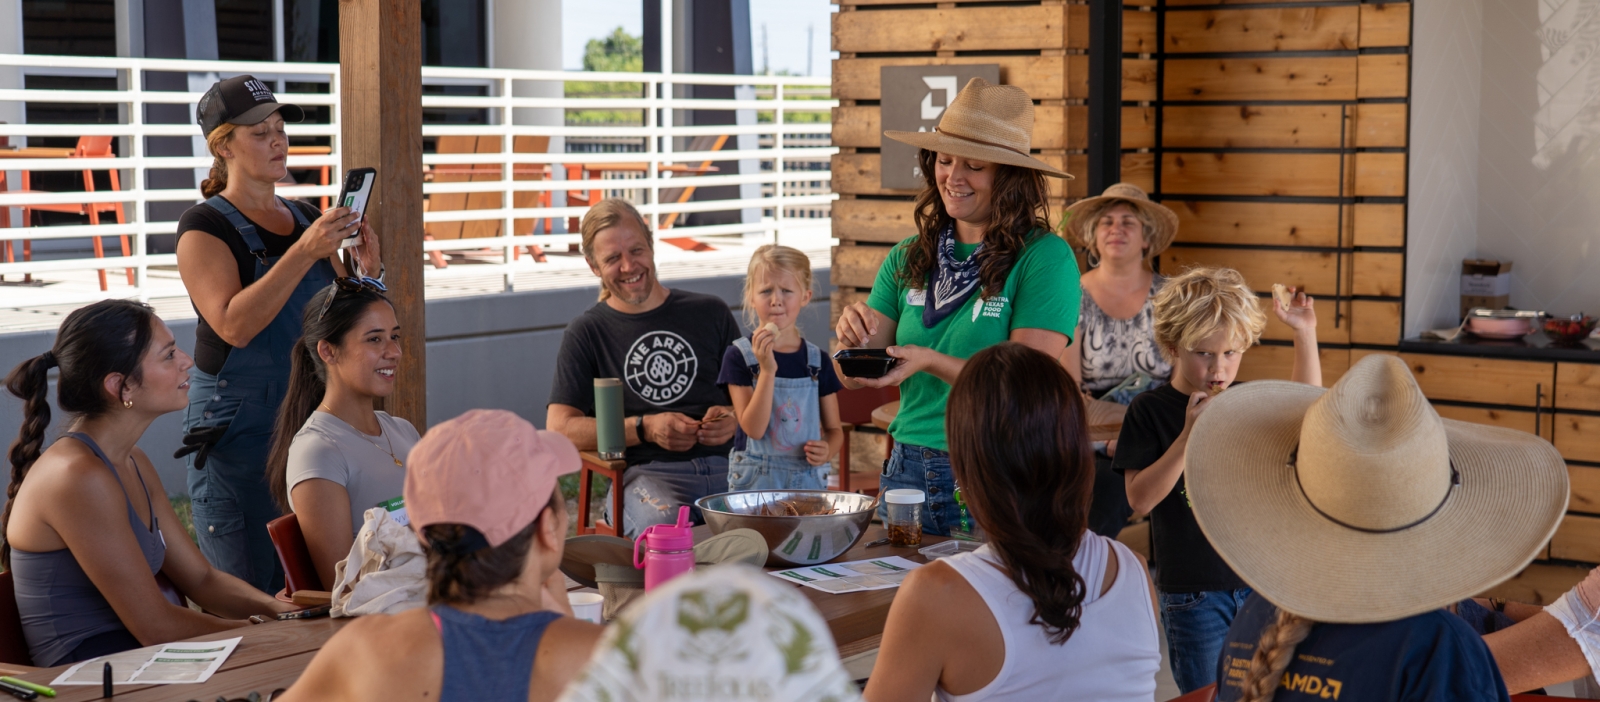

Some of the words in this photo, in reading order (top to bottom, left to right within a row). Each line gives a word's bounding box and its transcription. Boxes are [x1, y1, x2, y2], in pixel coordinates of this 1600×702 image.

[630, 343, 650, 365] WE
[653, 336, 685, 355] ARE
[641, 374, 689, 401] BLOOD
[1281, 671, 1323, 695] AMD
